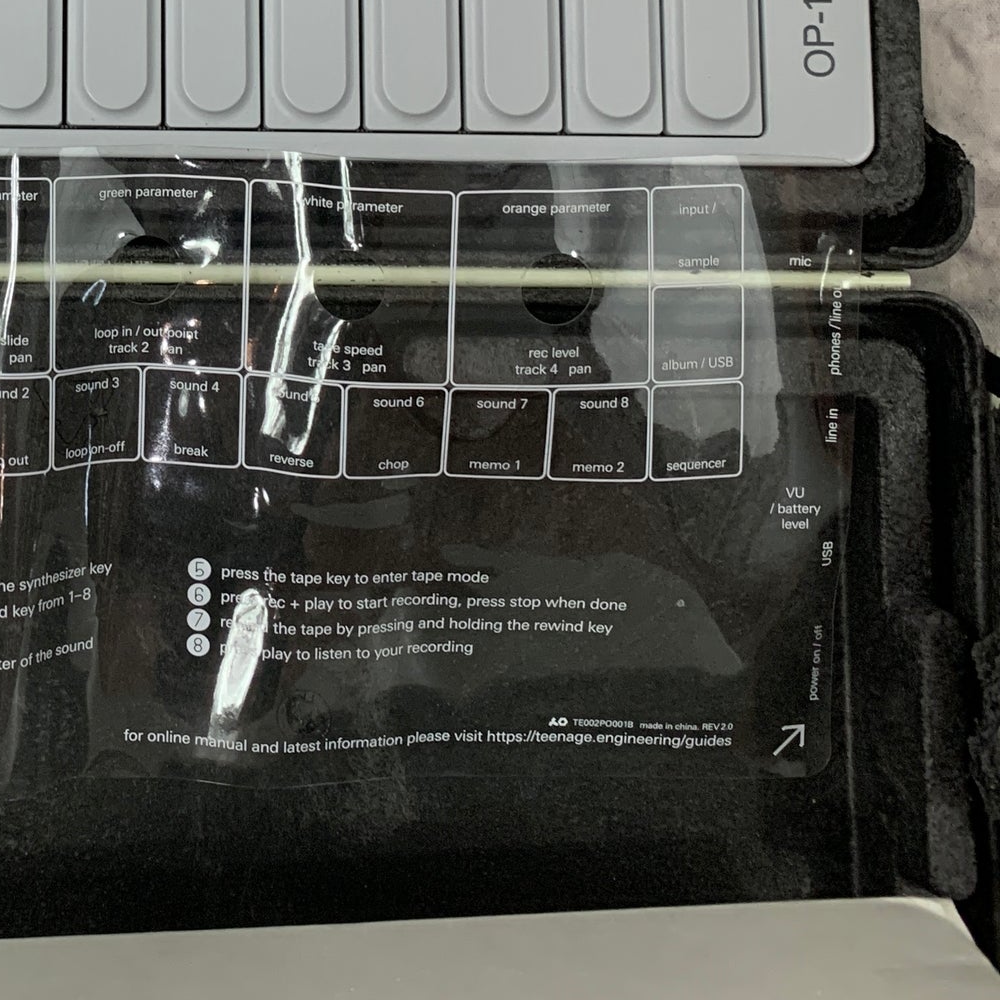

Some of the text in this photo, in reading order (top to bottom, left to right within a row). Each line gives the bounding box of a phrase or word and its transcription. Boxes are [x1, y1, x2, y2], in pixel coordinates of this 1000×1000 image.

[99, 188, 198, 201] green parameter
[502, 202, 610, 215] orange parameter
[679, 204, 709, 215] input
[678, 257, 719, 267] sample
[789, 256, 811, 267] mic
[109, 342, 149, 354] track 2
[528, 346, 579, 358] rec level
[515, 363, 591, 375] track 4 pan
[662, 357, 733, 371] album USB
[75, 379, 120, 392] sound 3
[170, 379, 220, 392] sound 4
[373, 396, 424, 408] sound 6
[477, 398, 528, 409] sound 7
[580, 397, 629, 408] sound 8
[825, 408, 839, 443] line in
[174, 444, 208, 457] break
[269, 453, 314, 467] reverse
[378, 459, 409, 470] chop
[469, 459, 520, 470] memo 1
[666, 459, 726, 472] sequencer
[572, 462, 624, 472] memo 2
[786, 488, 805, 498] VU
[778, 504, 821, 516] battery
[781, 519, 809, 529] level
[822, 541, 833, 566] USB
[20, 566, 86, 592] synthesizer
[90, 562, 112, 576] key
[195, 562, 489, 587] 5 press the tape key to enter tape mode
[13, 604, 35, 618] key
[38, 595, 64, 612] from
[809, 625, 823, 701] power on off
[124, 729, 143, 741] for
[147, 731, 190, 744] online
[195, 735, 247, 751] manual
[252, 742, 279, 753] and
[283, 741, 321, 753] latest
[325, 735, 402, 750] information
[407, 730, 449, 746] please
[455, 730, 482, 742] visit
